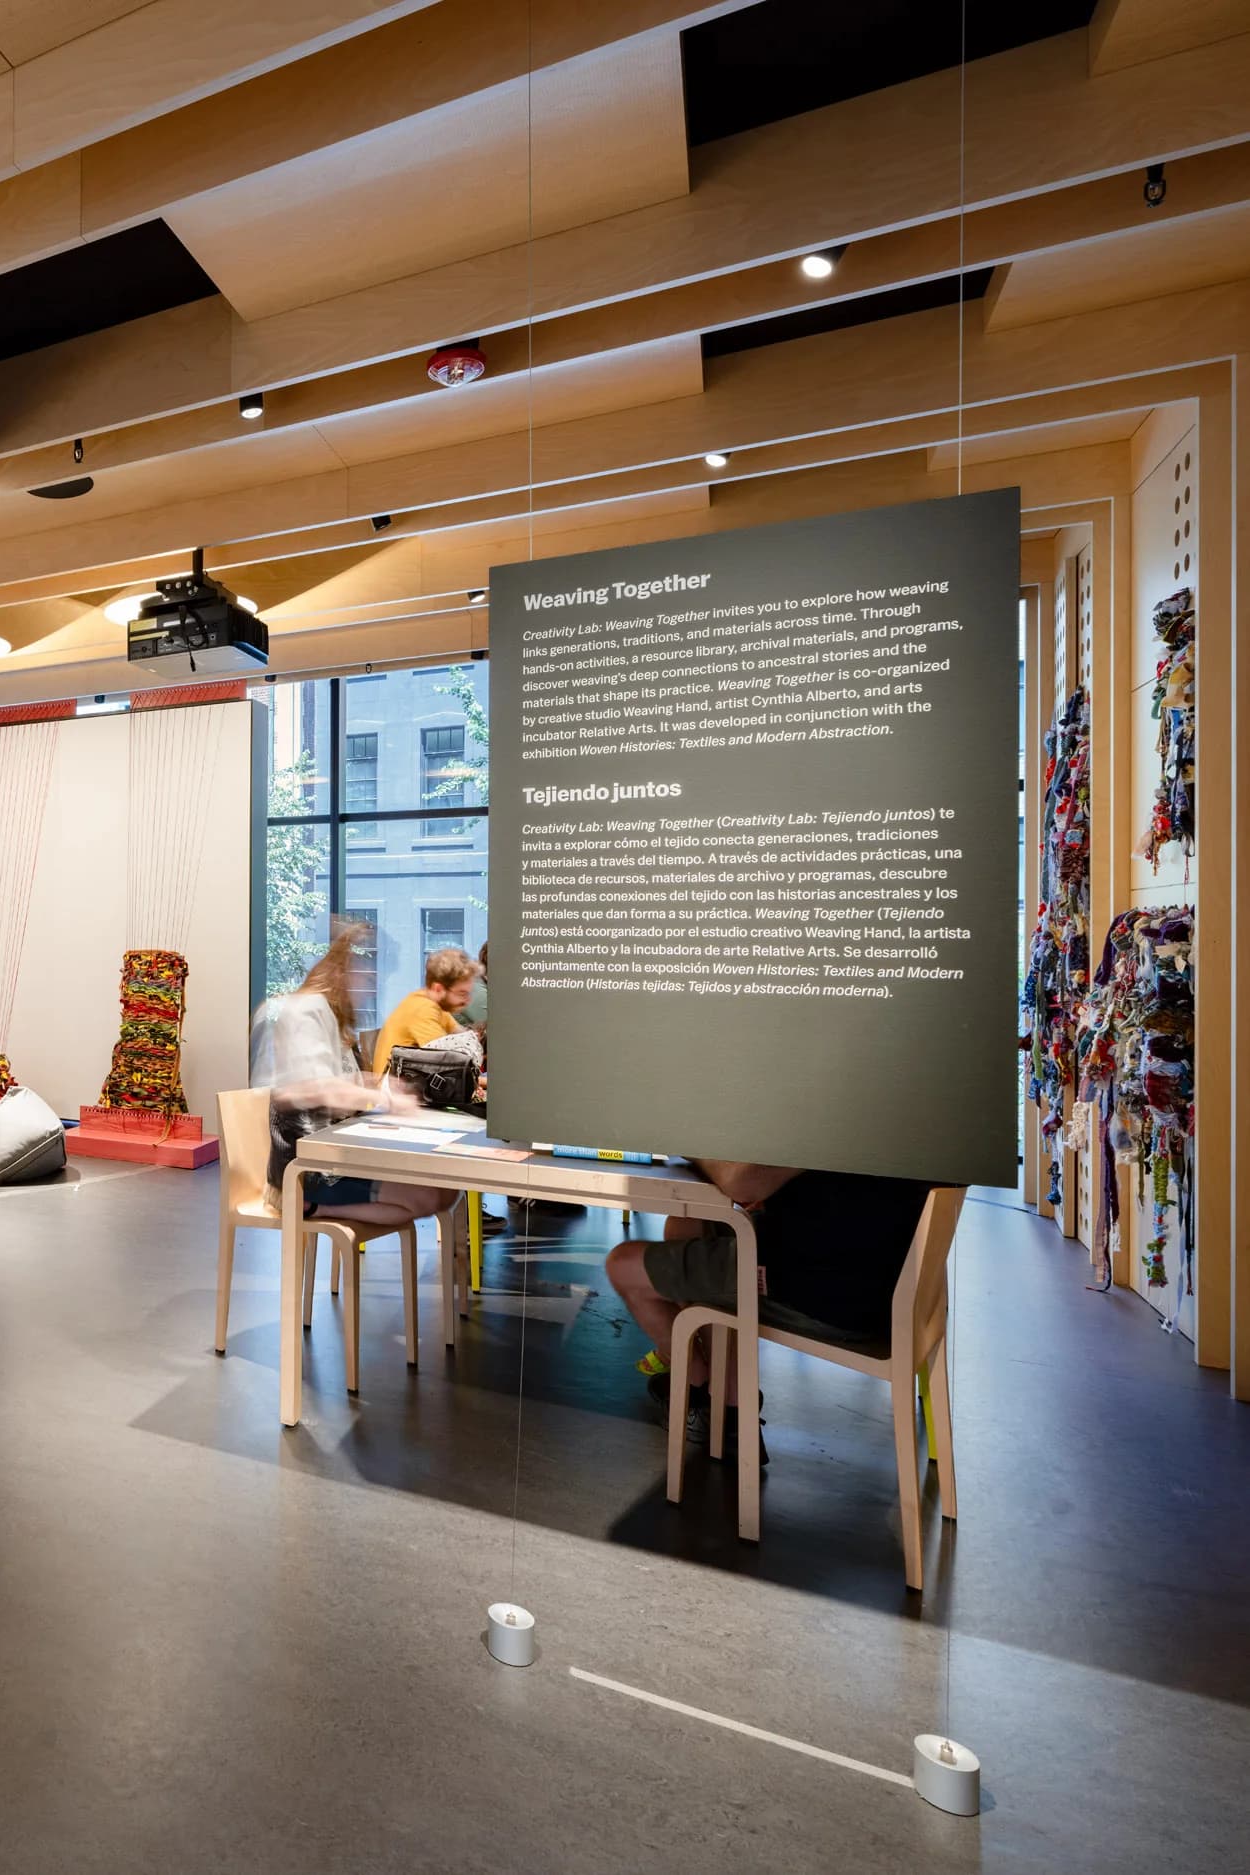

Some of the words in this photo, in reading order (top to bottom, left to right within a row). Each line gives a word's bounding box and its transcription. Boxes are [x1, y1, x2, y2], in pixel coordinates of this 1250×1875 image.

[523, 587, 608, 610] Weaving
[612, 573, 710, 599] Together
[522, 626, 575, 640] Creativity
[578, 622, 602, 634] Lab:
[605, 617, 654, 631] Weaving
[656, 610, 710, 625] Together
[712, 605, 754, 618] invites
[757, 602, 780, 615] you
[784, 599, 798, 609] to
[801, 593, 853, 608] explore
[856, 589, 886, 600] how
[889, 581, 948, 596] weaving
[522, 647, 547, 658] links
[550, 639, 619, 656] generations,
[623, 632, 683, 646] traditions,
[686, 626, 709, 639] and
[713, 620, 771, 636] materials
[774, 616, 818, 629] across
[822, 612, 856, 624] time.
[860, 602, 920, 619] Through
[522, 662, 573, 674] hands-on
[575, 655, 628, 669] activities,
[631, 655, 638, 663] a
[641, 649, 693, 662] resource
[696, 644, 737, 656] library,
[740, 636, 789, 651] archival
[793, 630, 857, 646] materials,
[861, 625, 886, 639] and
[890, 620, 962, 638] programs,
[522, 695, 574, 708] materials
[577, 692, 600, 703] that
[603, 690, 638, 701] shape
[641, 687, 656, 698] its
[659, 682, 713, 698] practice.
[718, 677, 771, 690] Weaving
[775, 671, 835, 686] Together
[838, 668, 849, 680] is
[853, 658, 949, 678] co-organized
[522, 730, 576, 742] incubator
[579, 726, 625, 738] Relative
[628, 723, 656, 734] Arts.
[660, 721, 668, 731] It
[671, 721, 696, 730] was
[698, 713, 766, 728] developed
[770, 712, 781, 723] in
[785, 706, 868, 722] conjunction
[872, 702, 902, 715] with
[907, 701, 931, 712] the
[522, 746, 576, 759] exhibition
[580, 744, 616, 755] Woven
[619, 739, 675, 752] Histories:
[679, 735, 725, 748] Textiles
[728, 733, 753, 745] and
[755, 730, 806, 743] Modern
[808, 724, 893, 739] Abstraction.
[522, 783, 609, 806] Tejiendo
[610, 781, 681, 803] juntos
[522, 823, 576, 834] Creativity
[578, 821, 603, 832] Lab:
[606, 820, 655, 832] Weaving
[659, 817, 714, 831] Together
[716, 814, 785, 828] (Creativity
[788, 812, 817, 824] Lab:
[821, 810, 881, 824] Tejiendo
[882, 807, 935, 823] juntos)
[939, 807, 954, 818] te
[522, 840, 551, 851] invita
[554, 842, 561, 850] a
[563, 839, 611, 851] explorar
[614, 837, 647, 848] cómo
[650, 836, 660, 847] el
[664, 835, 699, 848] tejido
[702, 834, 754, 845] conecta
[757, 831, 852, 846] generaciones,
[856, 828, 938, 840] tradiciones
[522, 874, 575, 885] biblioteca
[578, 873, 592, 884] de
[595, 875, 648, 884] recursos,
[652, 871, 715, 883] materiales
[718, 871, 734, 881] de
[736, 870, 784, 881] archivo
[787, 872, 795, 883] y
[798, 871, 875, 883] programas,
[879, 867, 947, 879] descubre
[522, 891, 537, 902] las
[539, 891, 596, 904] profundas
[599, 890, 666, 901] conexiones
[669, 890, 687, 900] del
[691, 889, 726, 902] tejido
[729, 891, 753, 900] con
[756, 889, 774, 900] las
[778, 888, 835, 900] historias
[838, 887, 920, 899] ancestrales
[924, 890, 932, 901] y
[936, 887, 957, 898] los
[522, 908, 579, 919] materiales
[581, 910, 603, 920] que
[605, 908, 627, 918] dan
[630, 908, 666, 918] forma
[668, 910, 675, 918] a
[678, 910, 692, 918] su
[696, 907, 751, 920] práctica.
[755, 907, 810, 921] Weaving
[813, 907, 874, 921] Together
[877, 907, 944, 921] (Tejiendo
[521, 942, 563, 955] Cynthia
[566, 943, 608, 954] Alberto
[610, 946, 618, 956] y
[620, 943, 630, 954] la
[633, 943, 701, 955] incubadora
[704, 944, 720, 955] de
[722, 945, 749, 956] arte
[752, 945, 804, 956] Relative
[807, 946, 839, 957] Arts.
[843, 946, 861, 957] Se
[864, 946, 937, 958] desarrolló
[520, 976, 584, 988] Abstraction
[586, 978, 639, 990] (Historias
[642, 980, 684, 992] tejidas:
[688, 980, 731, 994] Tejidos
[733, 984, 742, 995] y
[743, 982, 819, 995] abstracción
[822, 984, 892, 998] moderna).
[599, 1151, 623, 1159] words
